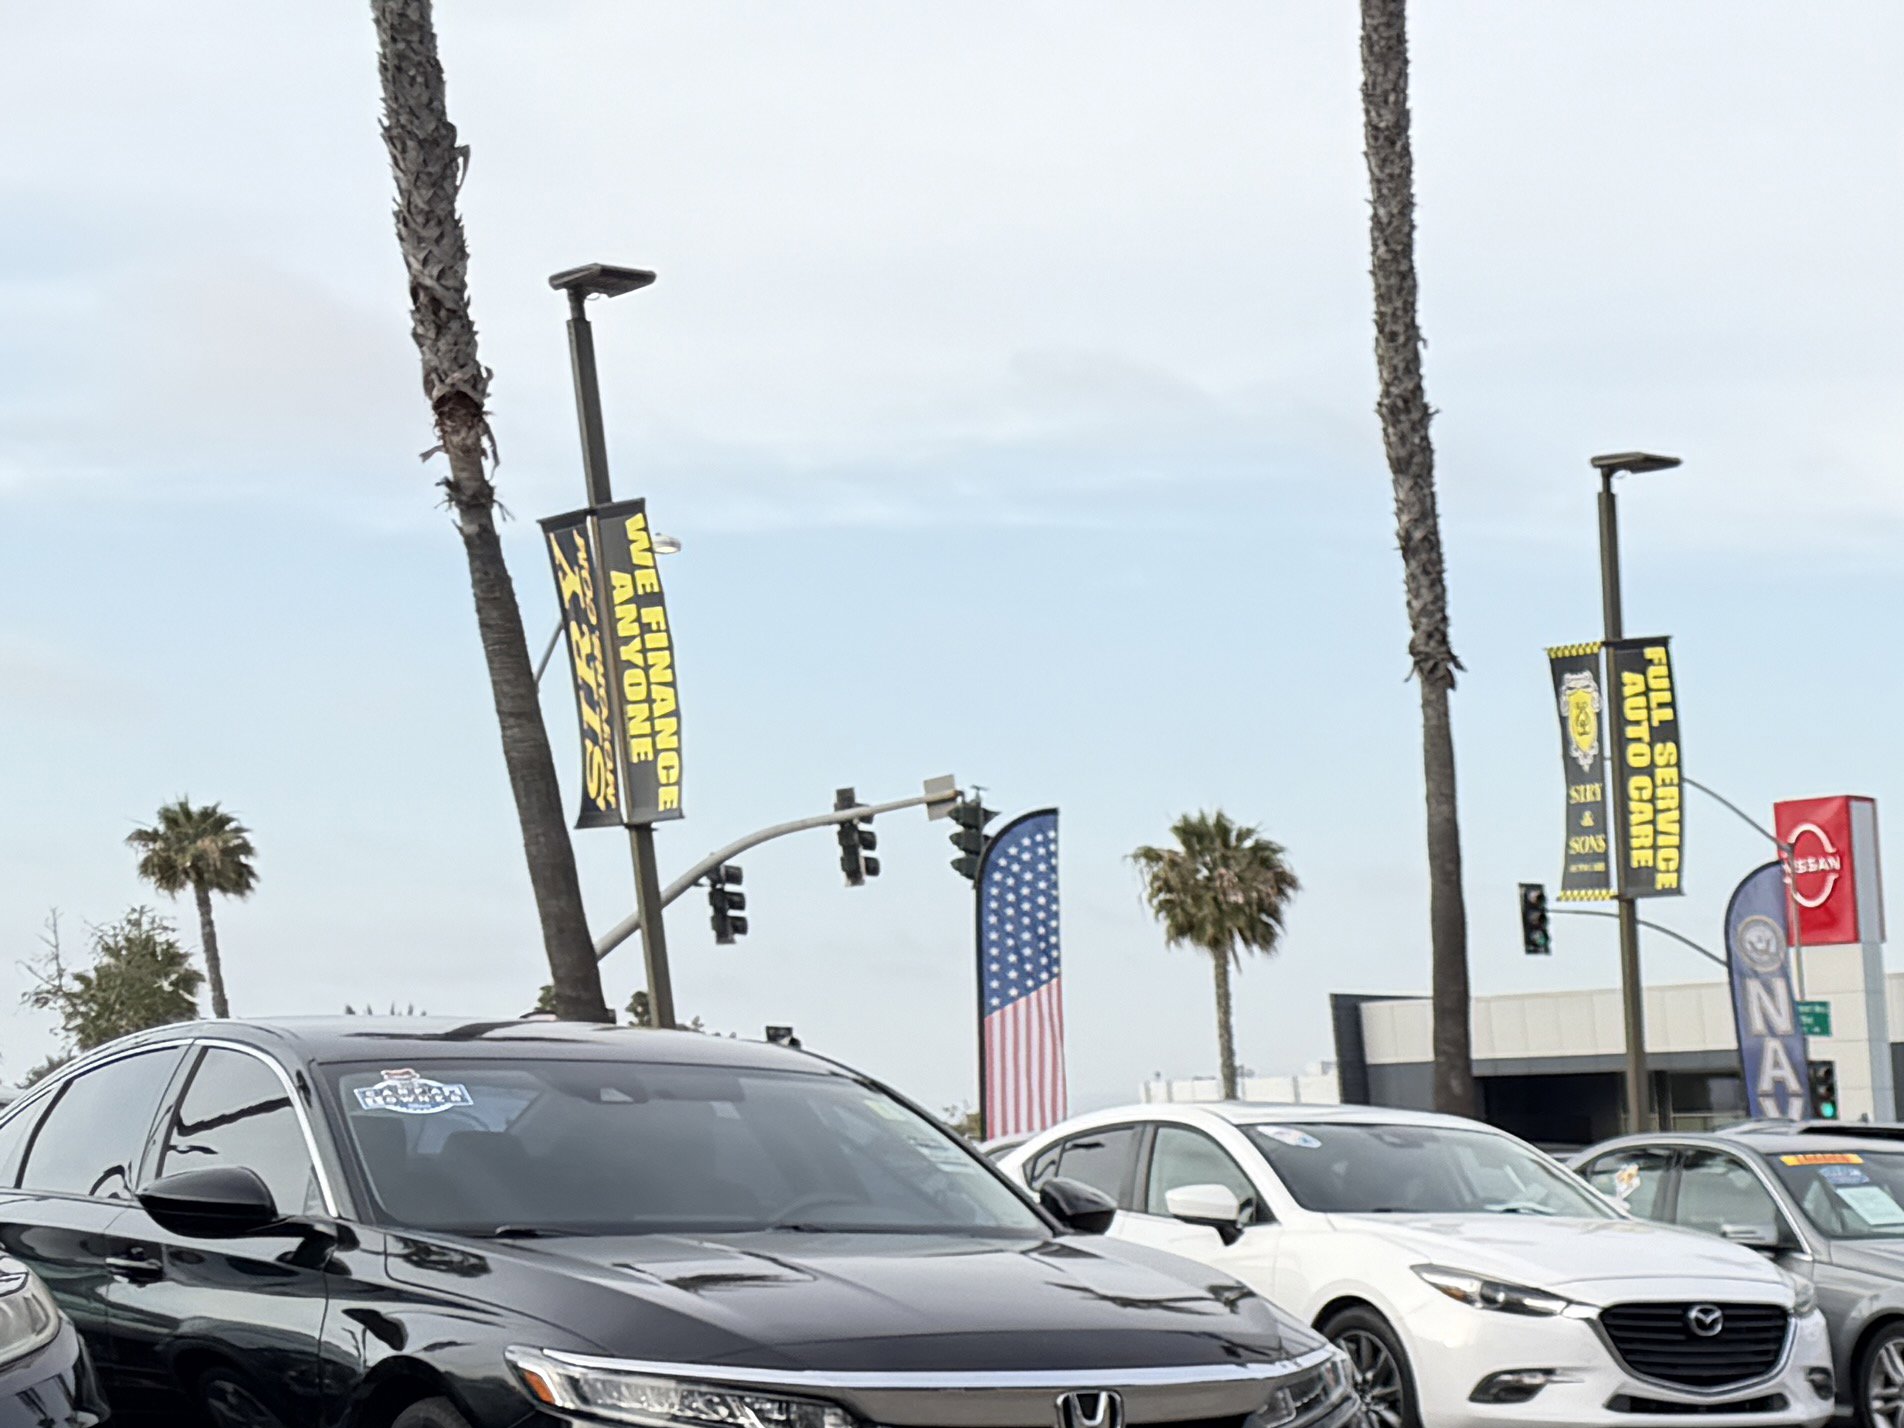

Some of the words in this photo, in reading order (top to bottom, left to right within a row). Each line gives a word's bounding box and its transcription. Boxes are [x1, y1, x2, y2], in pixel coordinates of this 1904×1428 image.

[625, 512, 659, 594] WE
[548, 532, 607, 812] SIRY
[609, 570, 654, 764] ANYONE
[640, 606, 680, 812] FINANCE
[1643, 646, 1674, 727] FULL
[1621, 671, 1651, 768] AUTO
[1568, 835, 1606, 854] SONS
[1628, 774, 1654, 868] CARE
[1654, 742, 1680, 890] SERVICE
